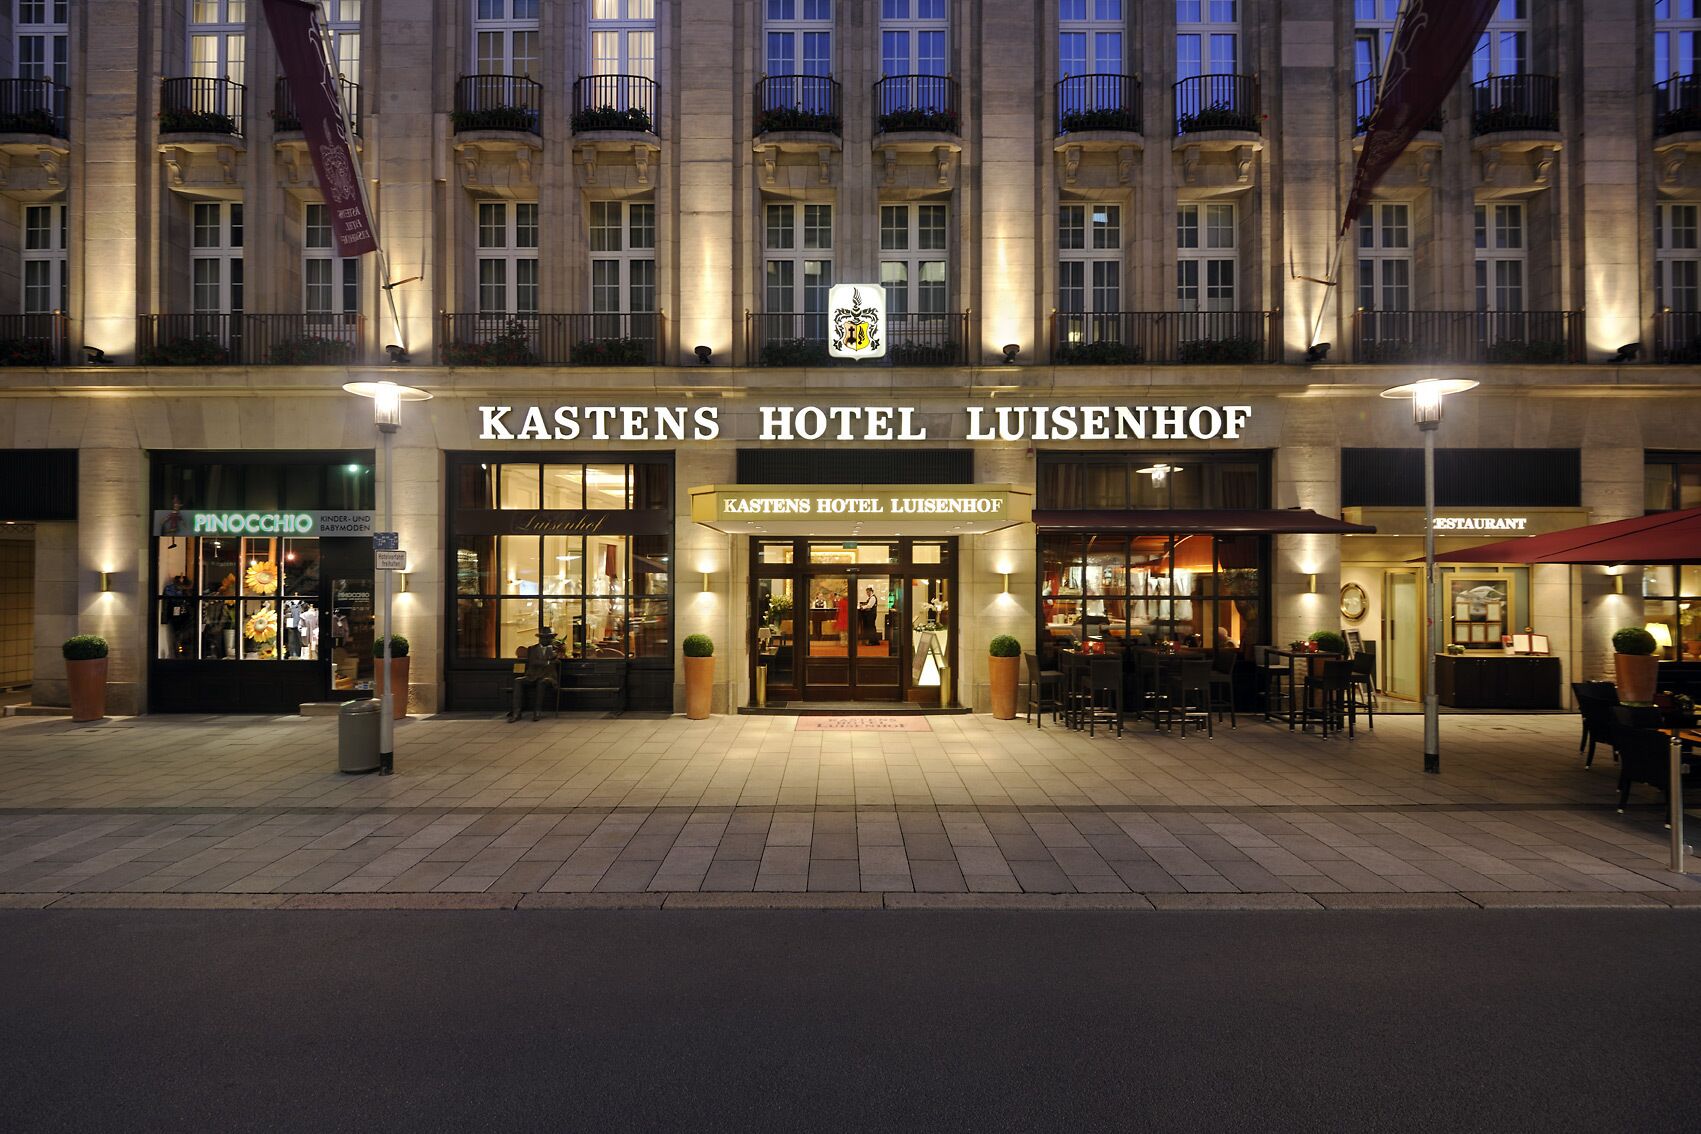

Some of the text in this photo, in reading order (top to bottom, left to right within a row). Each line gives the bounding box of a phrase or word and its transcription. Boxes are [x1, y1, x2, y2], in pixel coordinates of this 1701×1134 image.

[479, 405, 1252, 442] KASTENS HOTEL LUISENHOF
[723, 498, 1003, 513] KASTENS HOTEL LUISENHOF
[193, 512, 313, 534] PINOCCHIO
[320, 515, 371, 523] KINDER- UND
[320, 524, 371, 532] BABYMODEN
